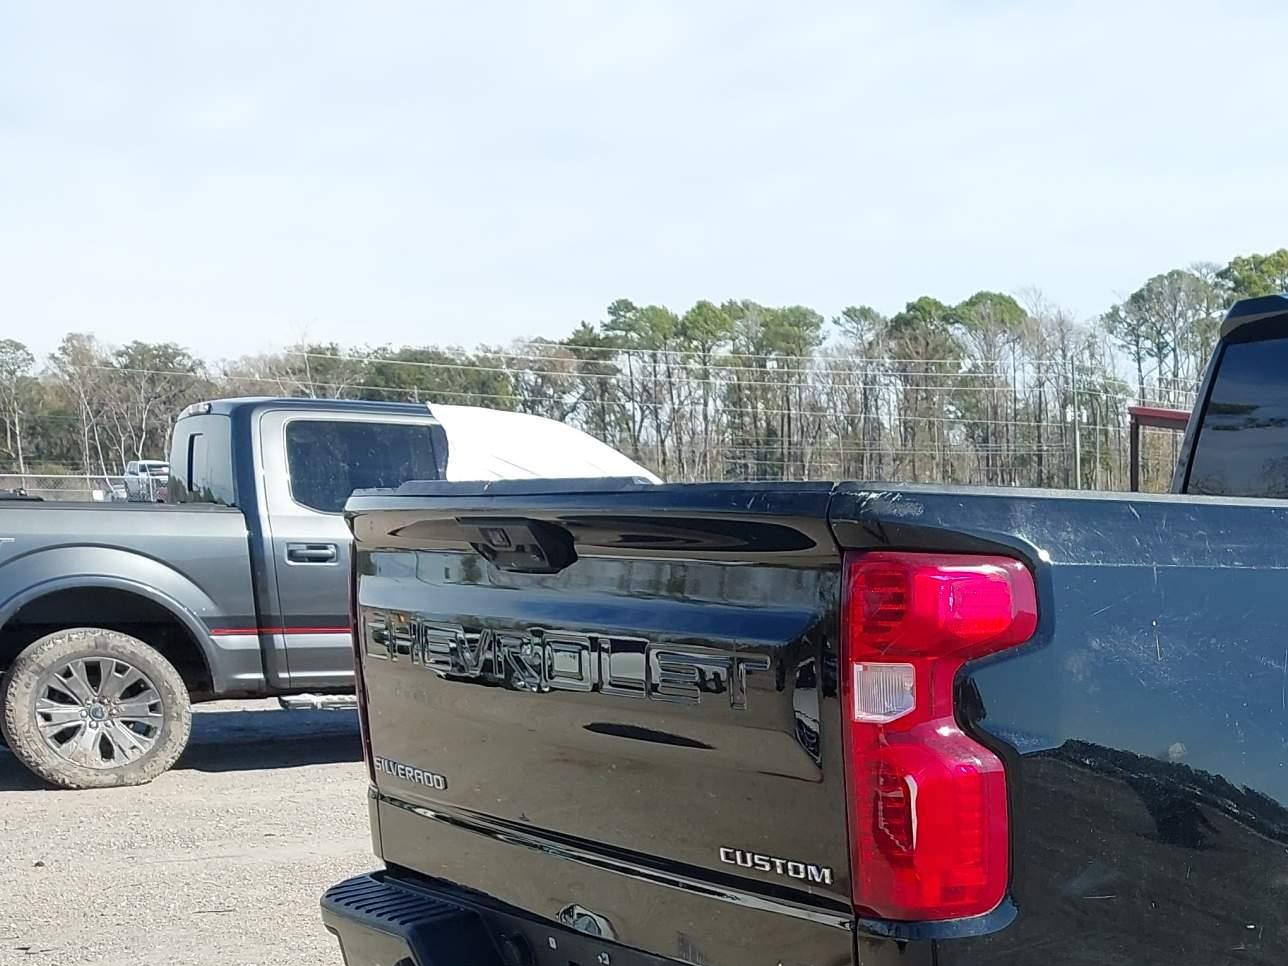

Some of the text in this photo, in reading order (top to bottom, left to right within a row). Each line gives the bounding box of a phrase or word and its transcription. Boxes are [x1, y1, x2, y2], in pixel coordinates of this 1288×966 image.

[363, 610, 772, 710] CHEVROLET
[374, 756, 448, 790] SILVERADO
[719, 846, 833, 885] CUSTOM
